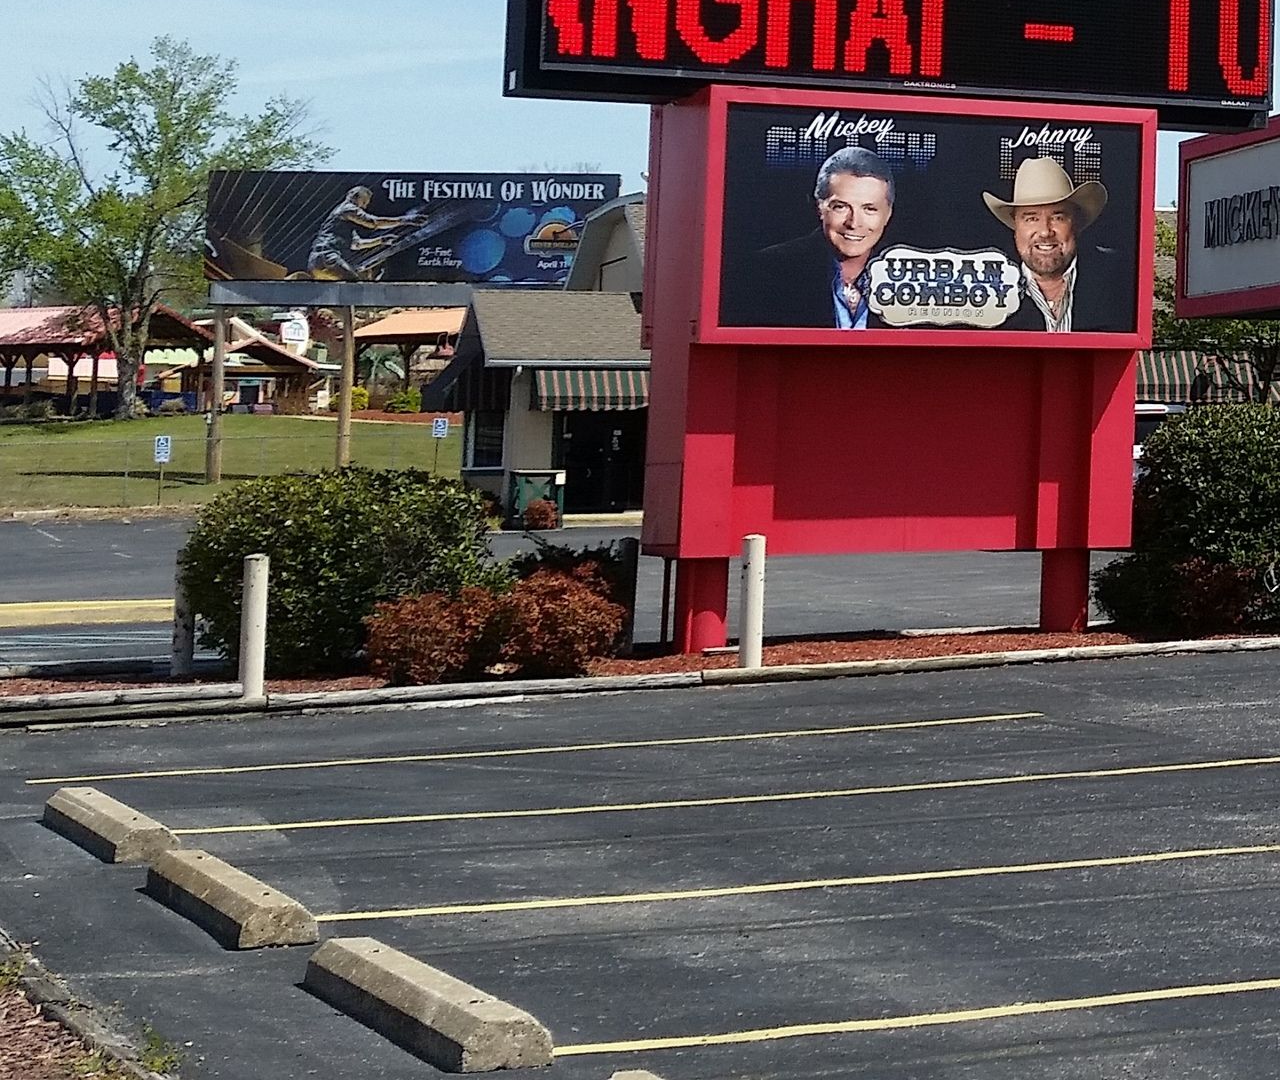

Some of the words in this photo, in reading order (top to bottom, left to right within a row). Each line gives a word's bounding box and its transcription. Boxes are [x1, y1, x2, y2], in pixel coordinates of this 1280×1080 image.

[903, 80, 957, 90] DAKTRONICS
[804, 110, 895, 143] Mickey
[1008, 122, 1094, 152] Johnny
[766, 126, 936, 168] GIEY
[537, 260, 559, 270] April
[885, 258, 1005, 284] URBAN
[874, 282, 1014, 307] COWBOY
[908, 307, 985, 318] REUNION
